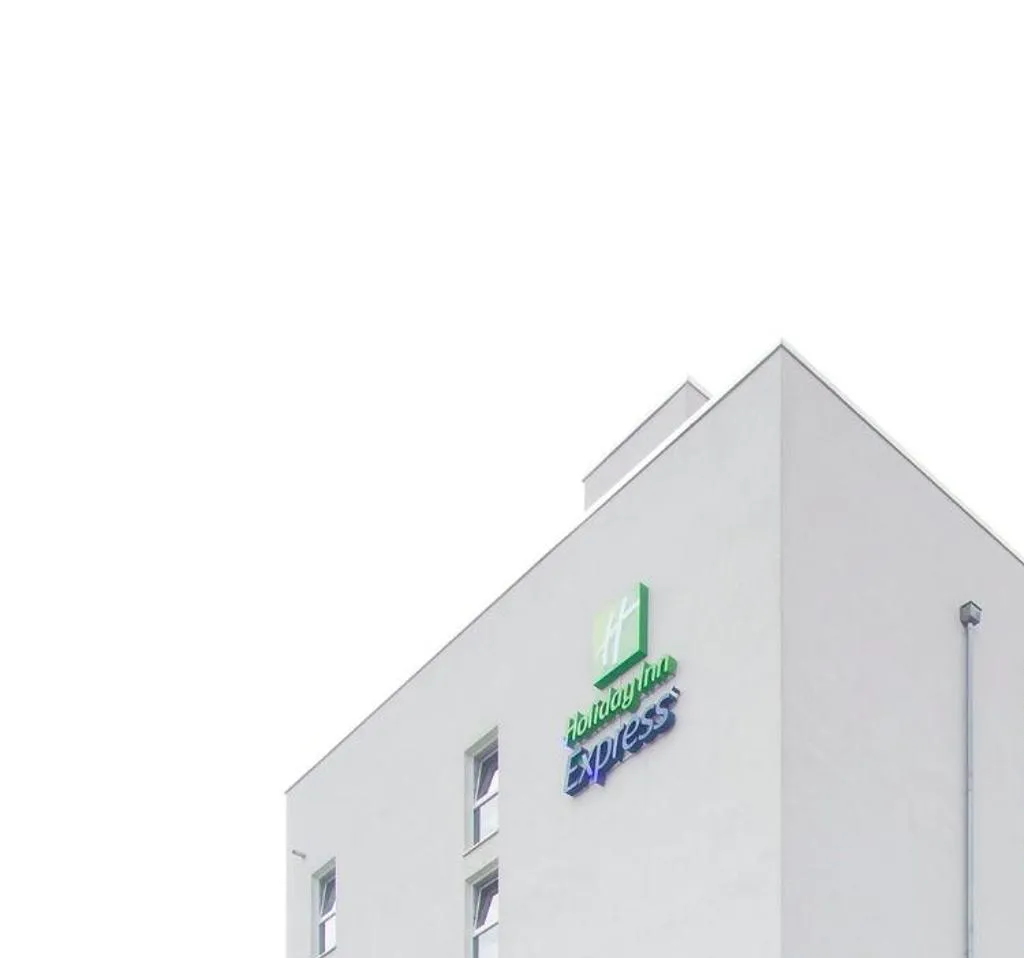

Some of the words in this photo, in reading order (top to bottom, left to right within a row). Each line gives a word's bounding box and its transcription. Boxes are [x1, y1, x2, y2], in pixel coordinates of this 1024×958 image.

[563, 692, 677, 796] Express
[566, 679, 641, 745] Holiday
[637, 655, 677, 696] Inn
